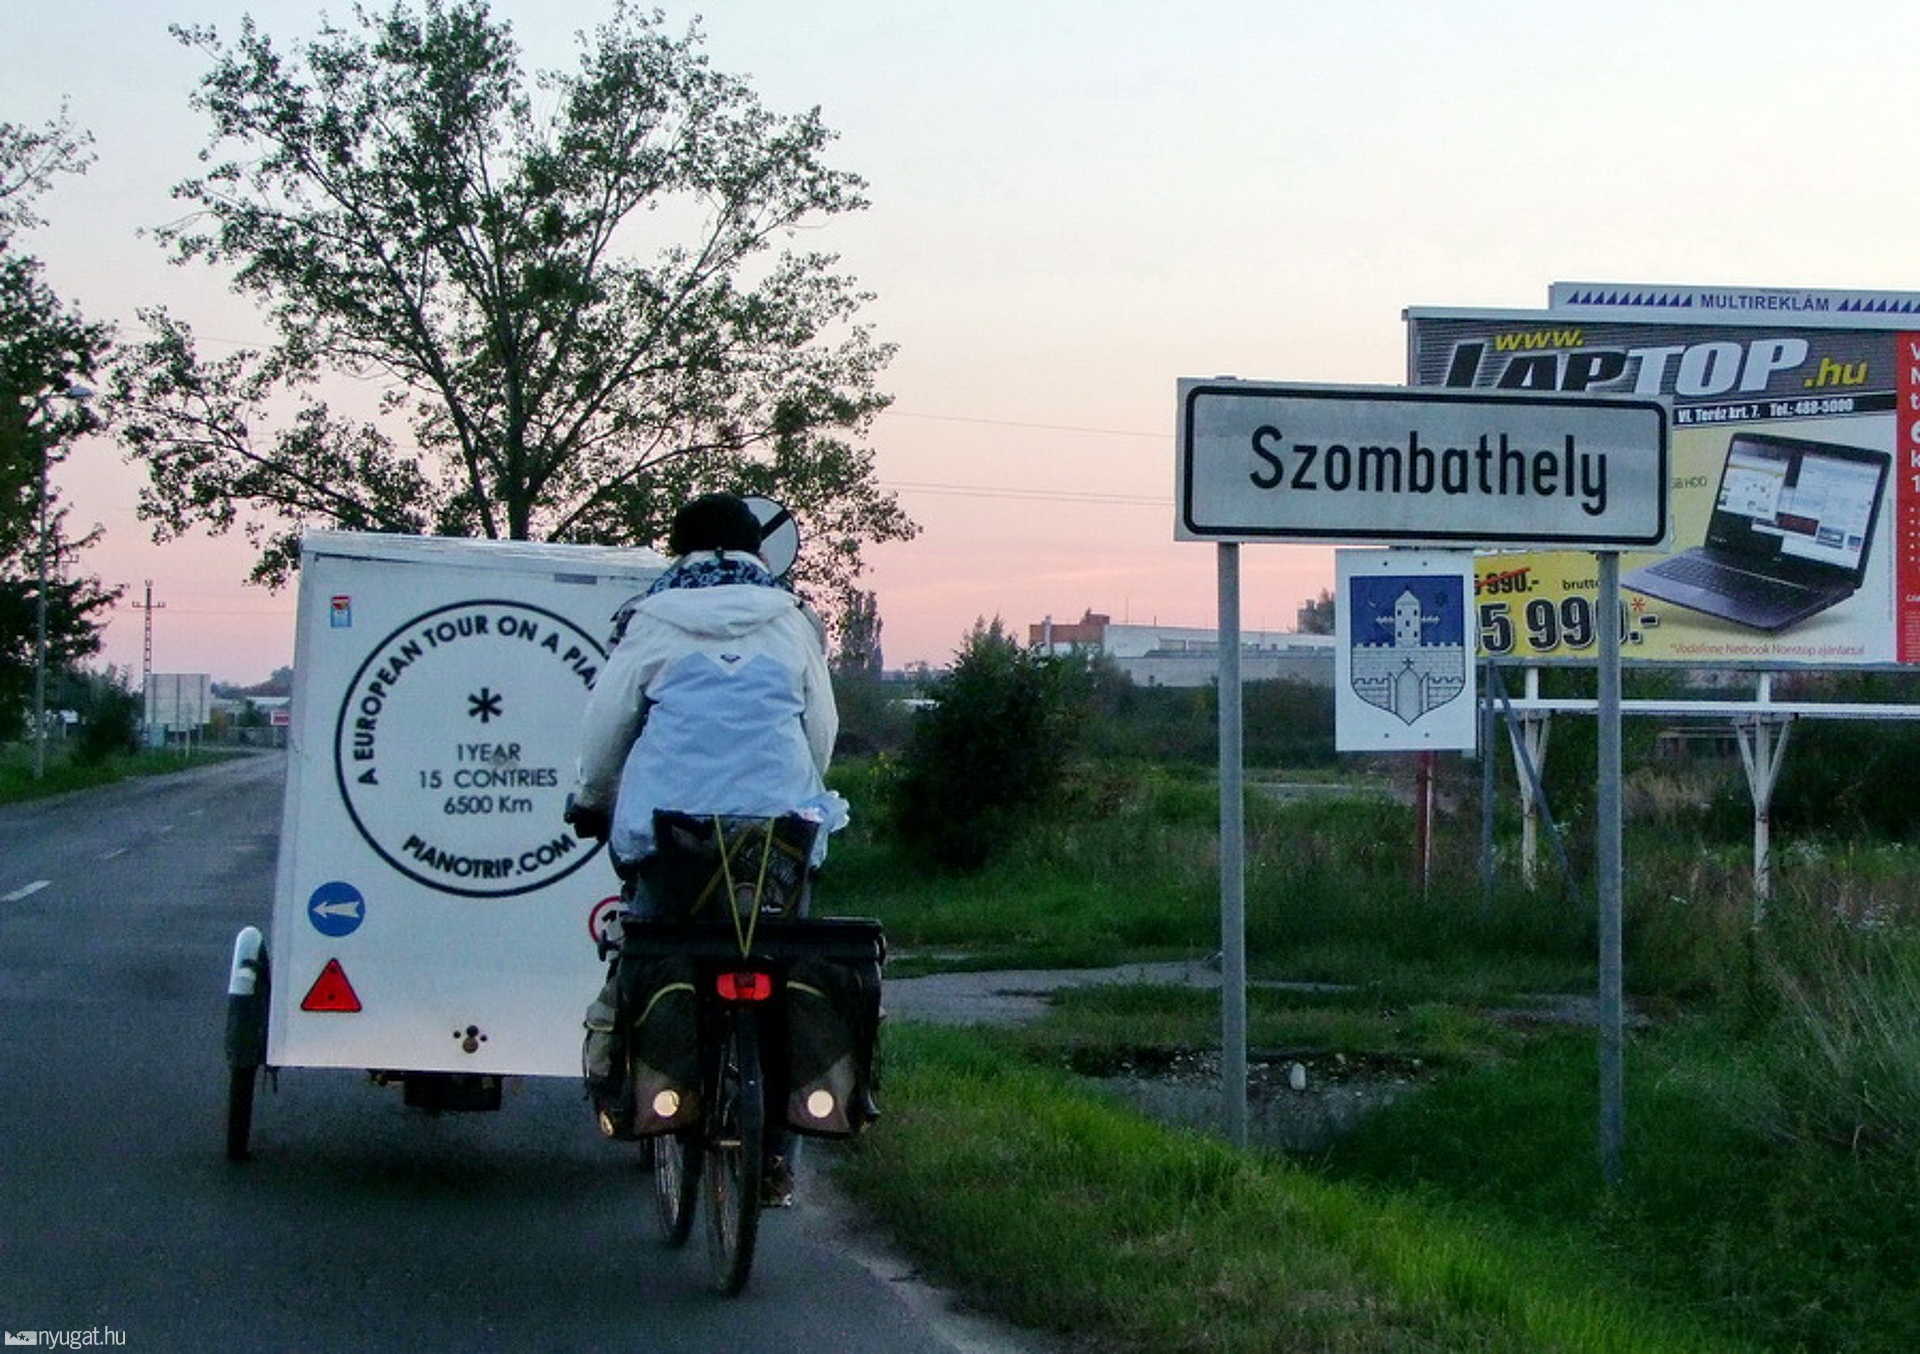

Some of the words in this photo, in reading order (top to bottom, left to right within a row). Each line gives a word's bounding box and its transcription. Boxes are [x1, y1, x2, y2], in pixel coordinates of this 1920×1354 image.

[1701, 292, 1829, 312] MULTIREKLÁM
[1494, 328, 1584, 350] www.
[1249, 425, 1608, 516] Szombathely
[423, 615, 489, 647] TOUR
[497, 615, 538, 642] ON
[1475, 602, 1513, 653] 5
[541, 633, 559, 654] A
[563, 646, 597, 692] PIA
[353, 640, 423, 761] EUROPEAN
[467, 743, 521, 763] YEAR
[358, 768, 379, 786] A
[419, 769, 443, 789] 15
[454, 768, 558, 789] CONTRIES
[443, 796, 493, 815] 6500
[498, 795, 533, 814] Km
[402, 833, 577, 879] PIANOTRIP.COM
